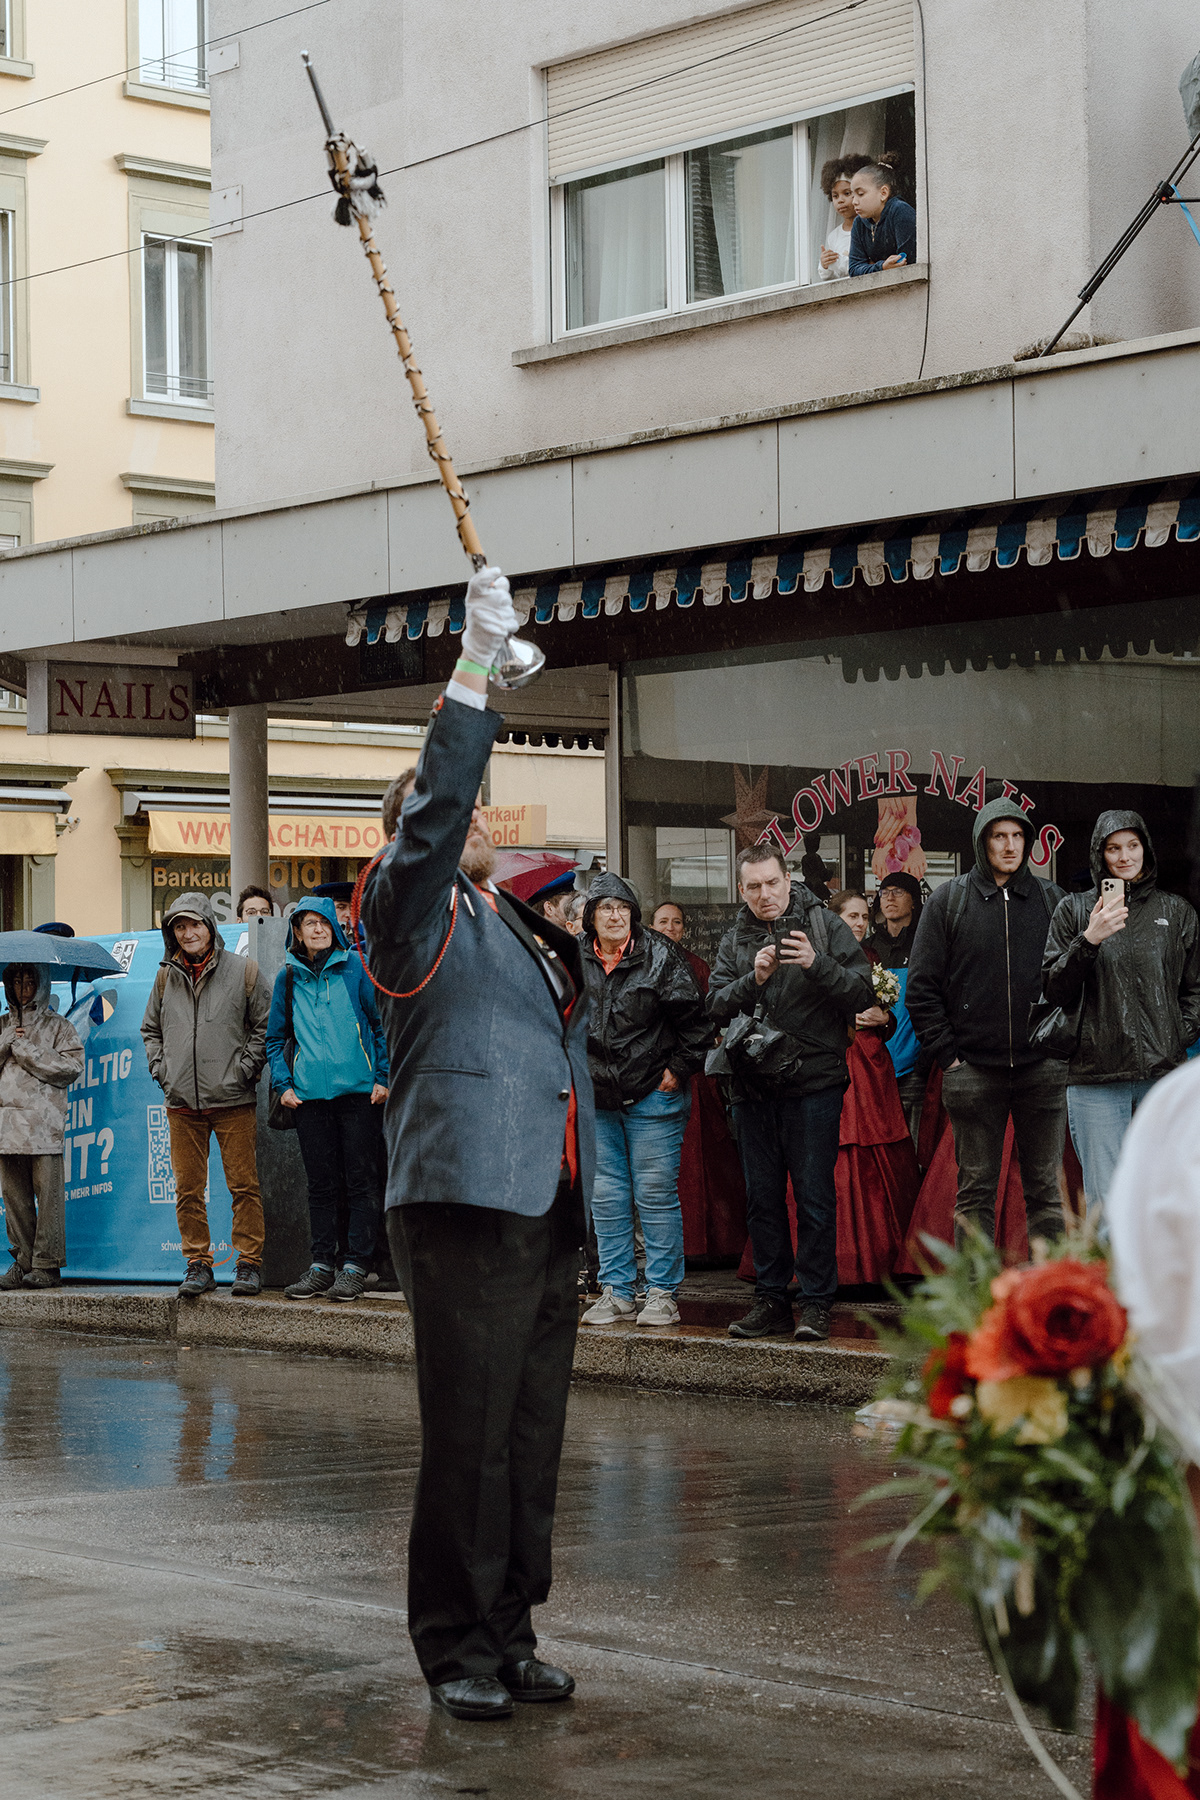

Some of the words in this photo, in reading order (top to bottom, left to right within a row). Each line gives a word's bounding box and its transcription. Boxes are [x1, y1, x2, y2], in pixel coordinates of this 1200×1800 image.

[56, 679, 190, 721] NAILS
[482, 805, 526, 823] arkauf
[488, 824, 519, 846] old
[269, 857, 322, 889] old
[68, 1048, 132, 1092] ALTIG
[71, 1186, 90, 1200] MEHR
[92, 1181, 113, 1195] INFOS
